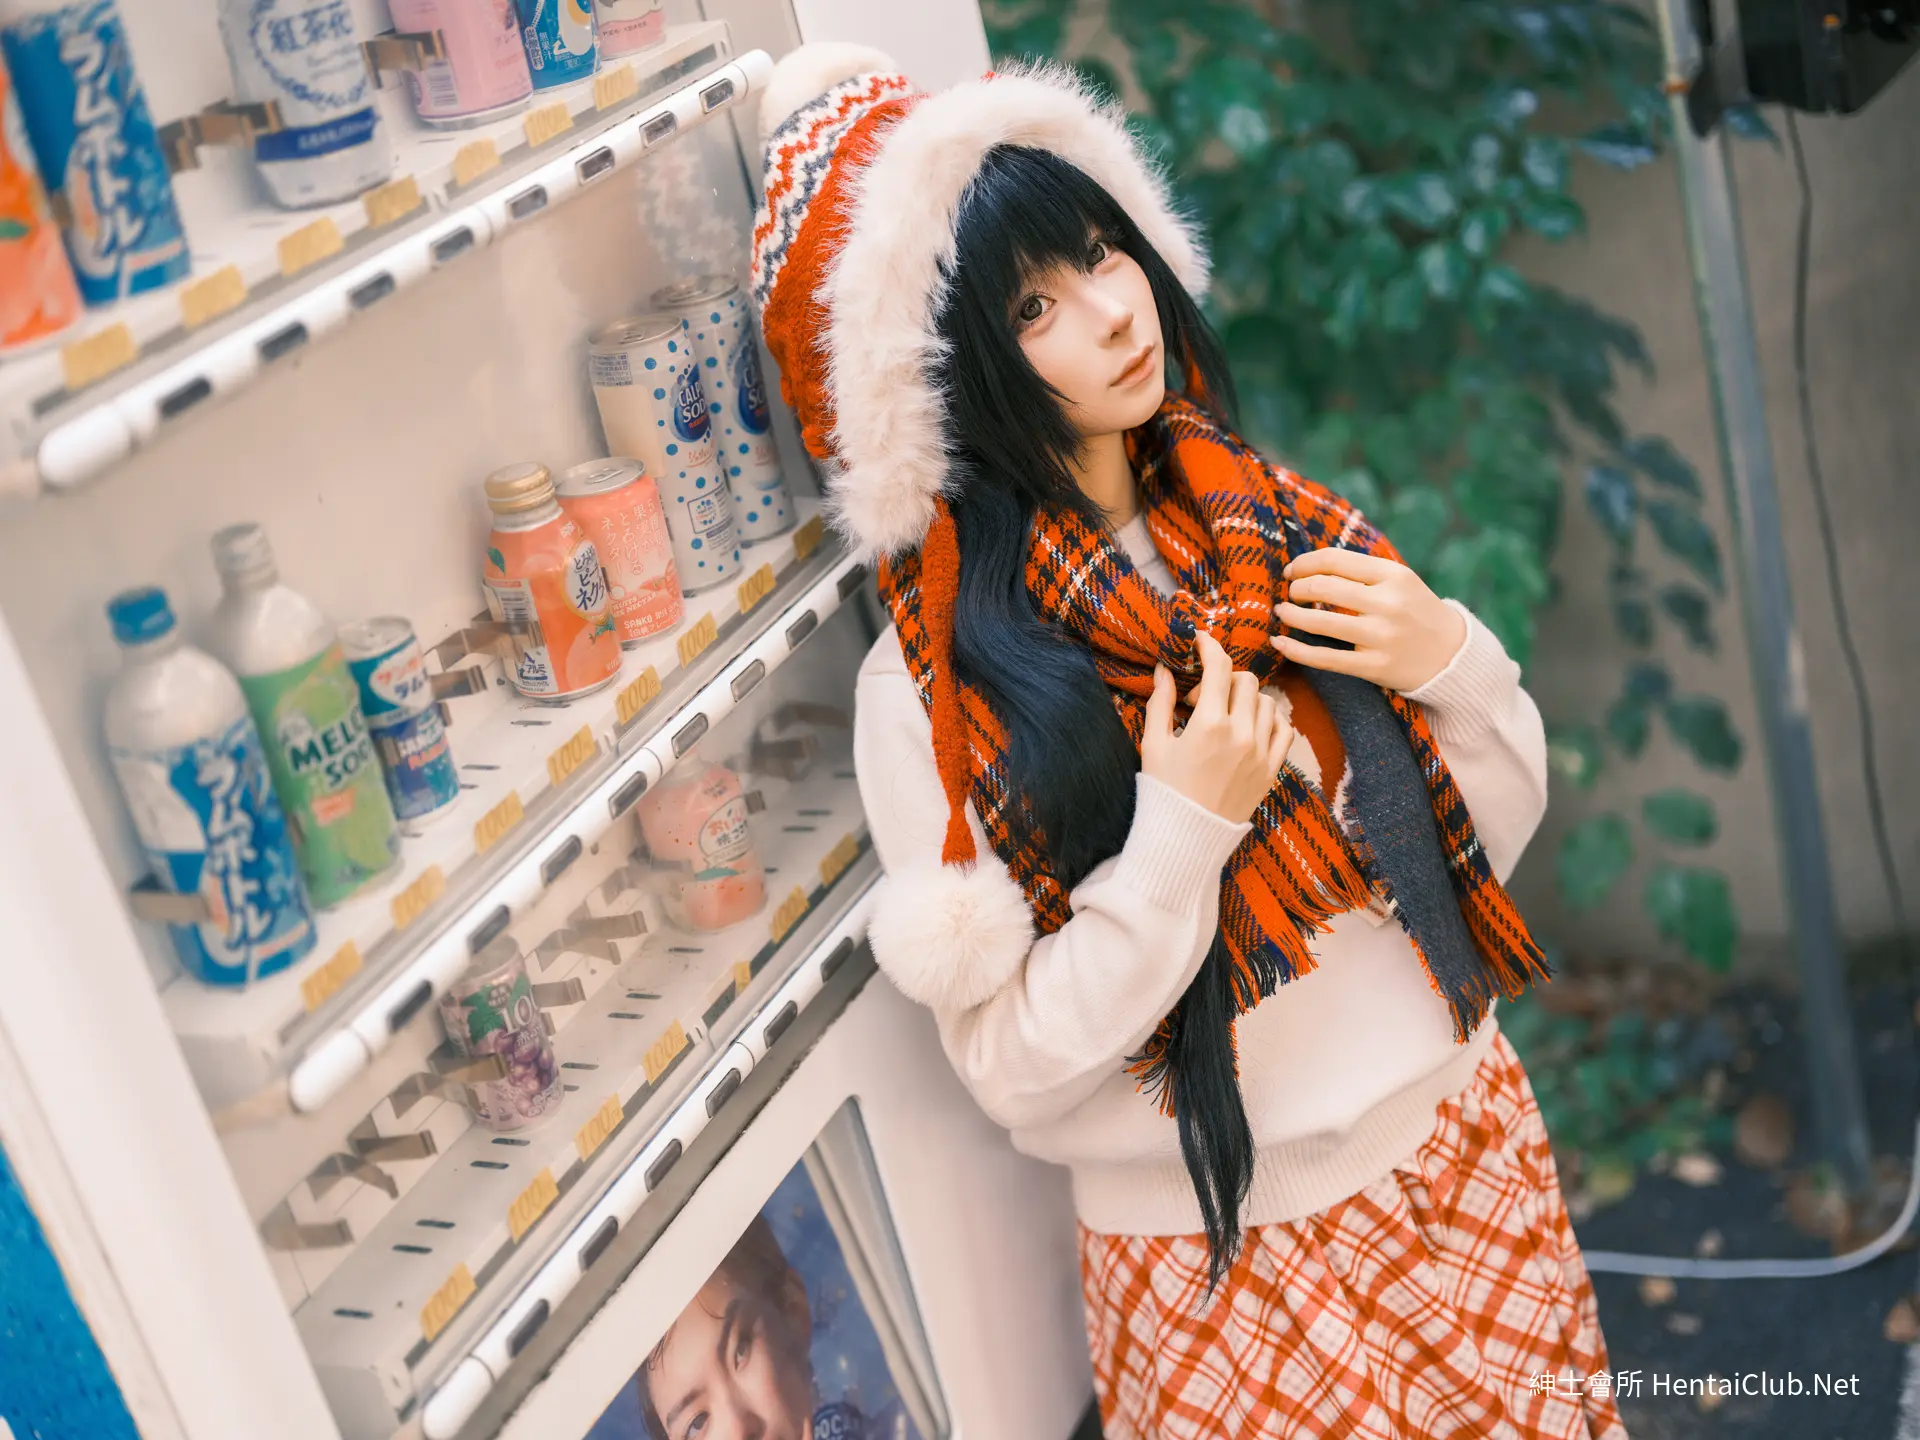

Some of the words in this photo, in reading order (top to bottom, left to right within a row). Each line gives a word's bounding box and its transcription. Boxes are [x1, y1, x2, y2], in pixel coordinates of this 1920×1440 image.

[601, 516, 621, 575] ネクター
[619, 511, 643, 576] とろける
[623, 614, 653, 630] SANKO
[525, 663, 547, 674] アルミ
